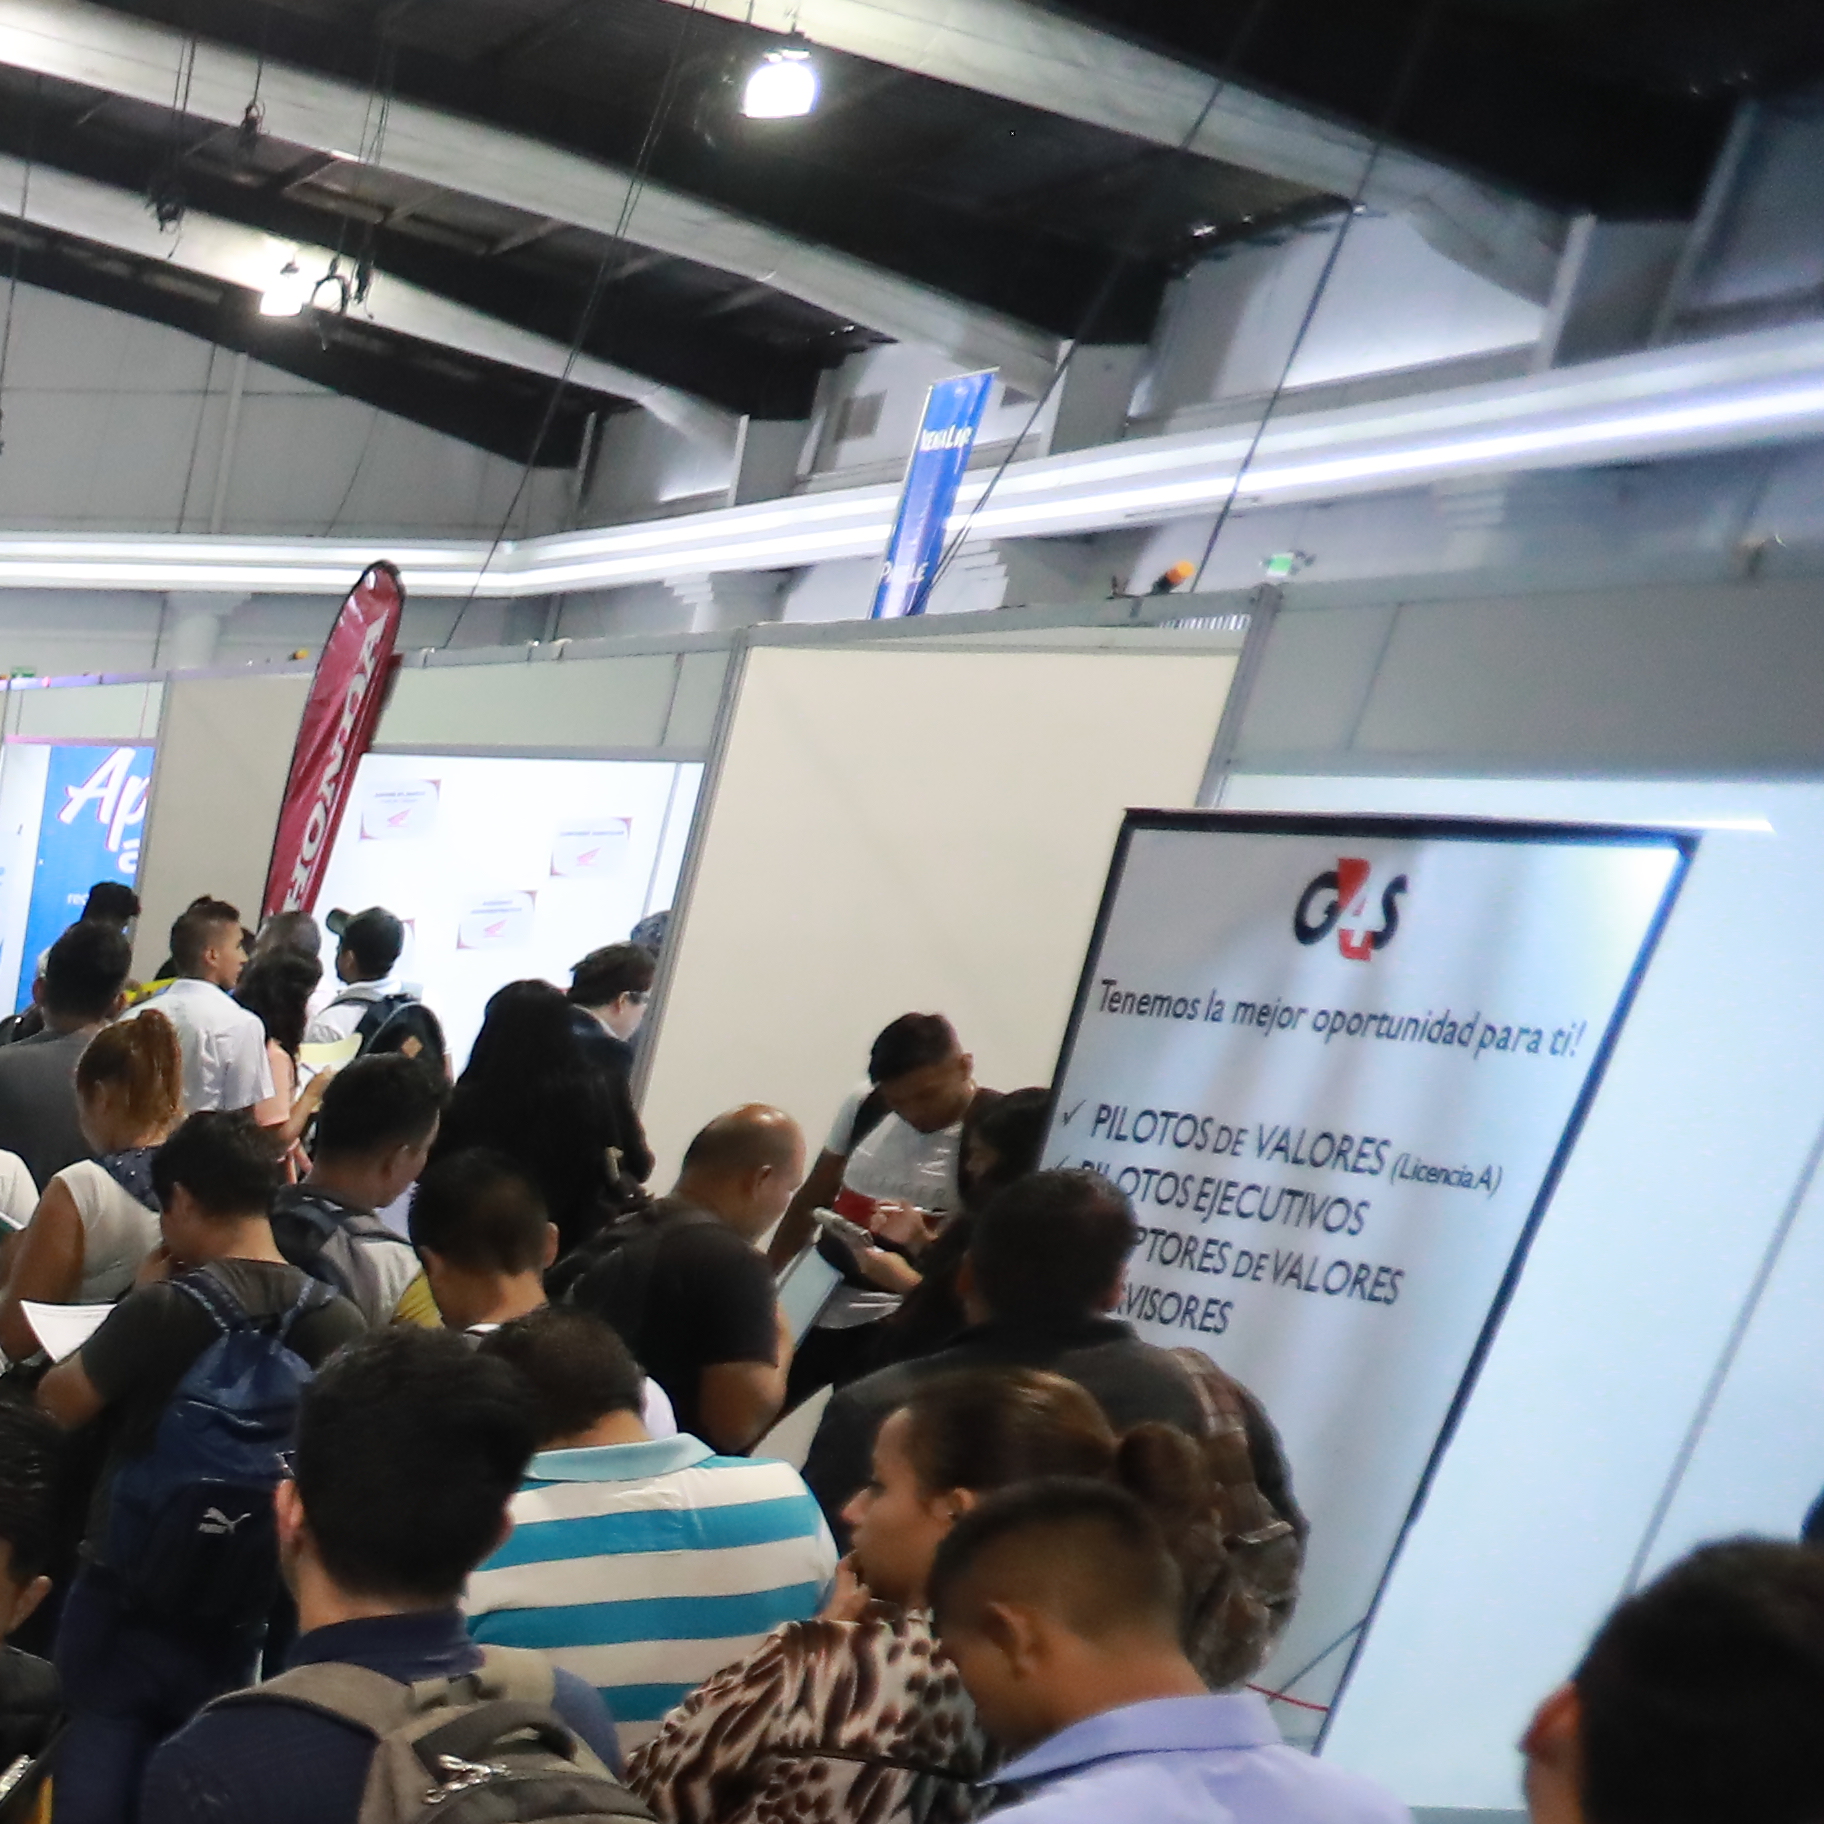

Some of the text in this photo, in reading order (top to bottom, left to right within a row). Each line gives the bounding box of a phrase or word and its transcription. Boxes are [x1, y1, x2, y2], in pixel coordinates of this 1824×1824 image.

[281, 608, 389, 912] HONDA
[1294, 857, 1409, 962] G4S
[1098, 979, 1588, 1060] Tenemos la mejor oportunidad para ti!
[1090, 1103, 1210, 1154] PILOTOS
[1212, 1125, 1246, 1157] DE
[1255, 1124, 1389, 1178] VALORES
[1193, 1177, 1370, 1237] EJECUTIVOS
[1116, 1283, 1234, 1335] VISORES
[1231, 1249, 1271, 1281] DE
[1270, 1252, 1404, 1306] VALORES
